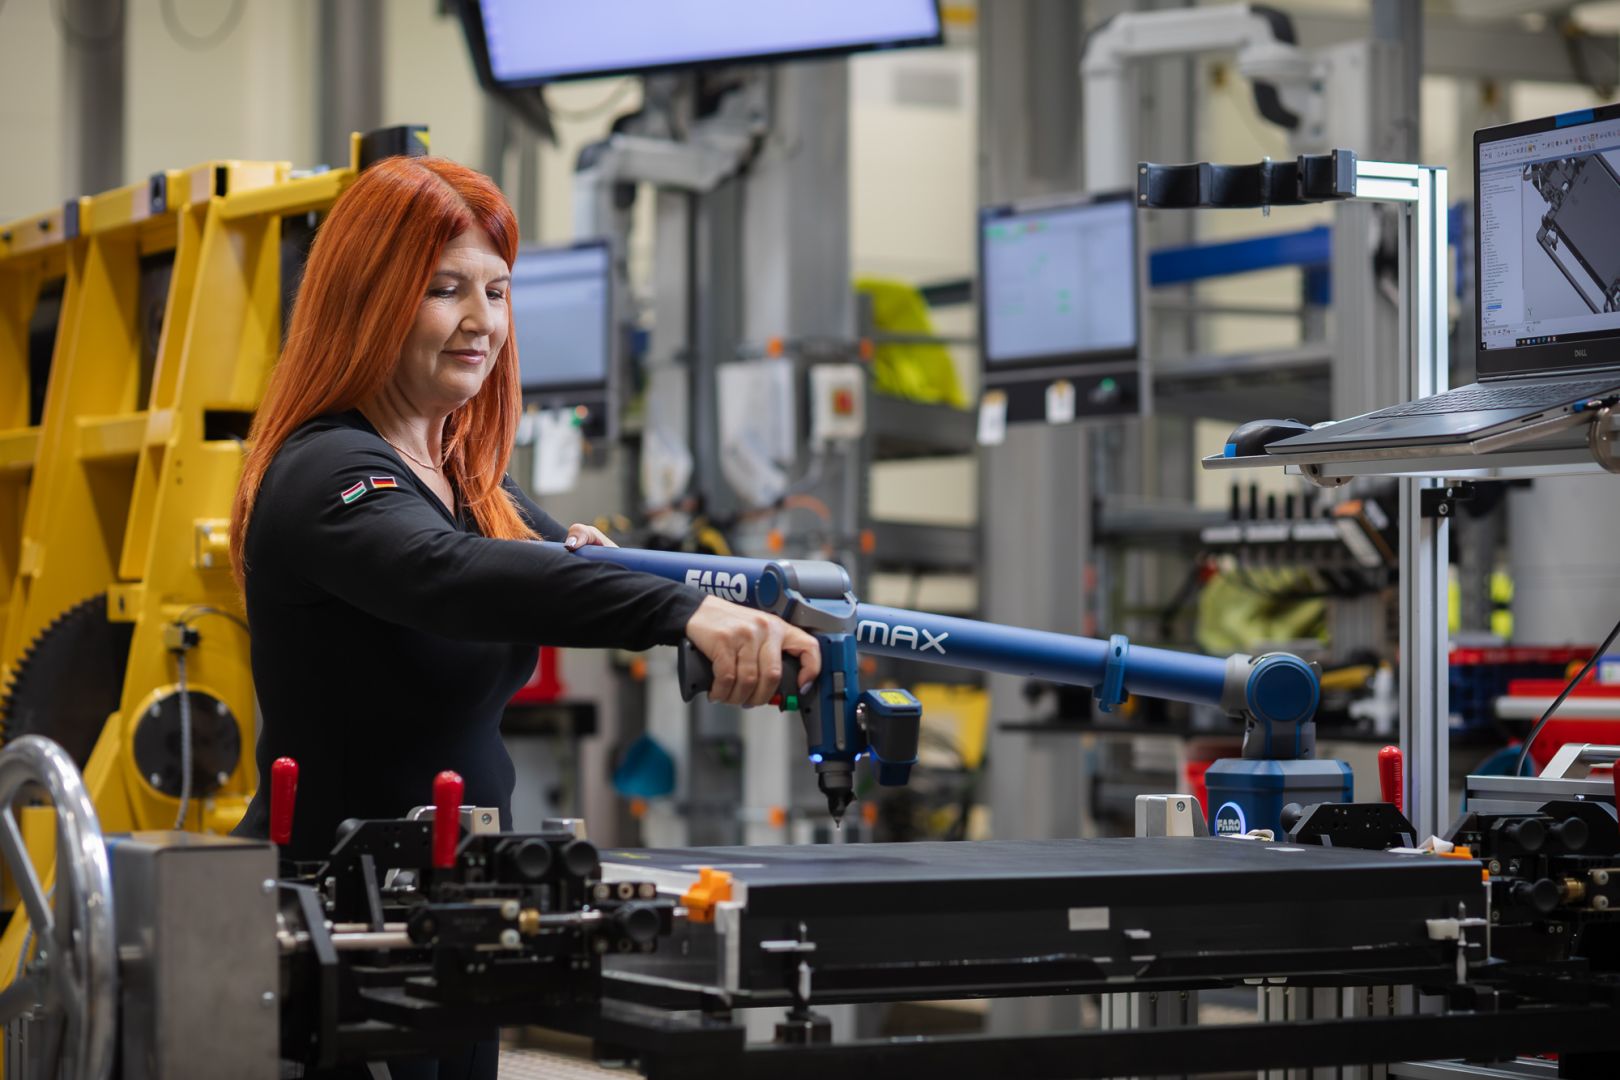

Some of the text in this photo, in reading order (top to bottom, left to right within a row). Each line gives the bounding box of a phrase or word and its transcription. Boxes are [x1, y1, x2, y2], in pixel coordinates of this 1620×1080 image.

[1574, 348, 1588, 358] DELL
[685, 569, 748, 603] FARO
[857, 620, 949, 655] MAX
[1217, 818, 1241, 832] FARO
